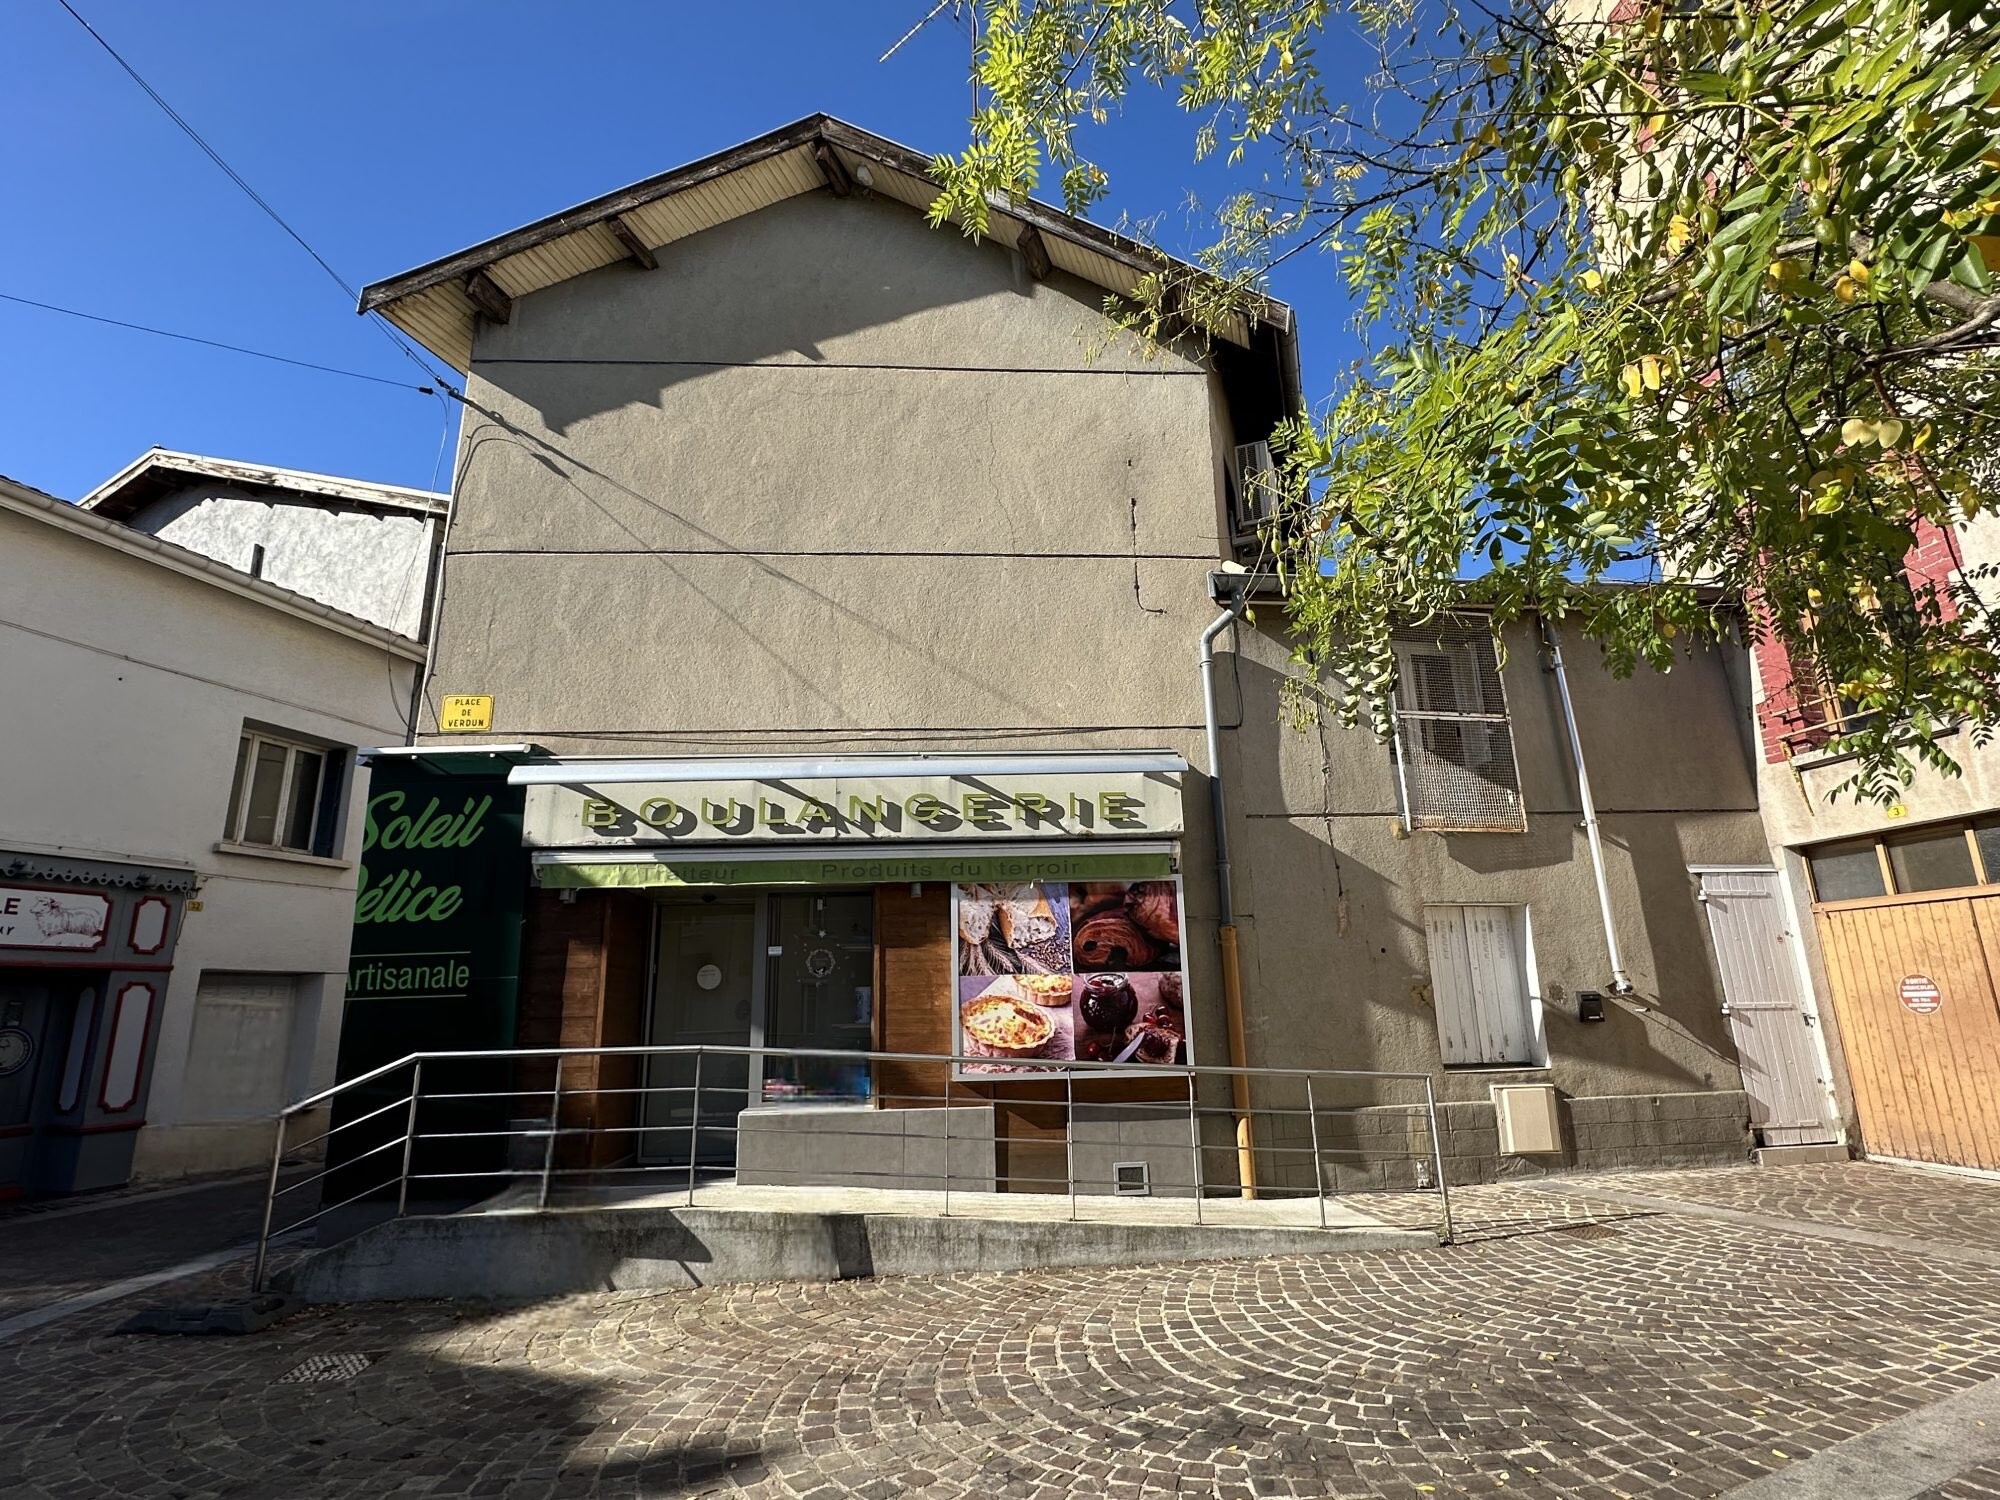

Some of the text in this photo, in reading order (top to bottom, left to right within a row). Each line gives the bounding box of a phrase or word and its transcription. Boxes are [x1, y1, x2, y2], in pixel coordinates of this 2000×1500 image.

[448, 719, 484, 727] VERDUN
[581, 791, 1129, 827] BOULANGERIE
[1893, 807, 1900, 816] 3
[362, 790, 493, 853] Soleil
[642, 866, 740, 882] Traiteur
[821, 858, 1081, 880] Produits du terroir
[354, 863, 463, 924] élice
